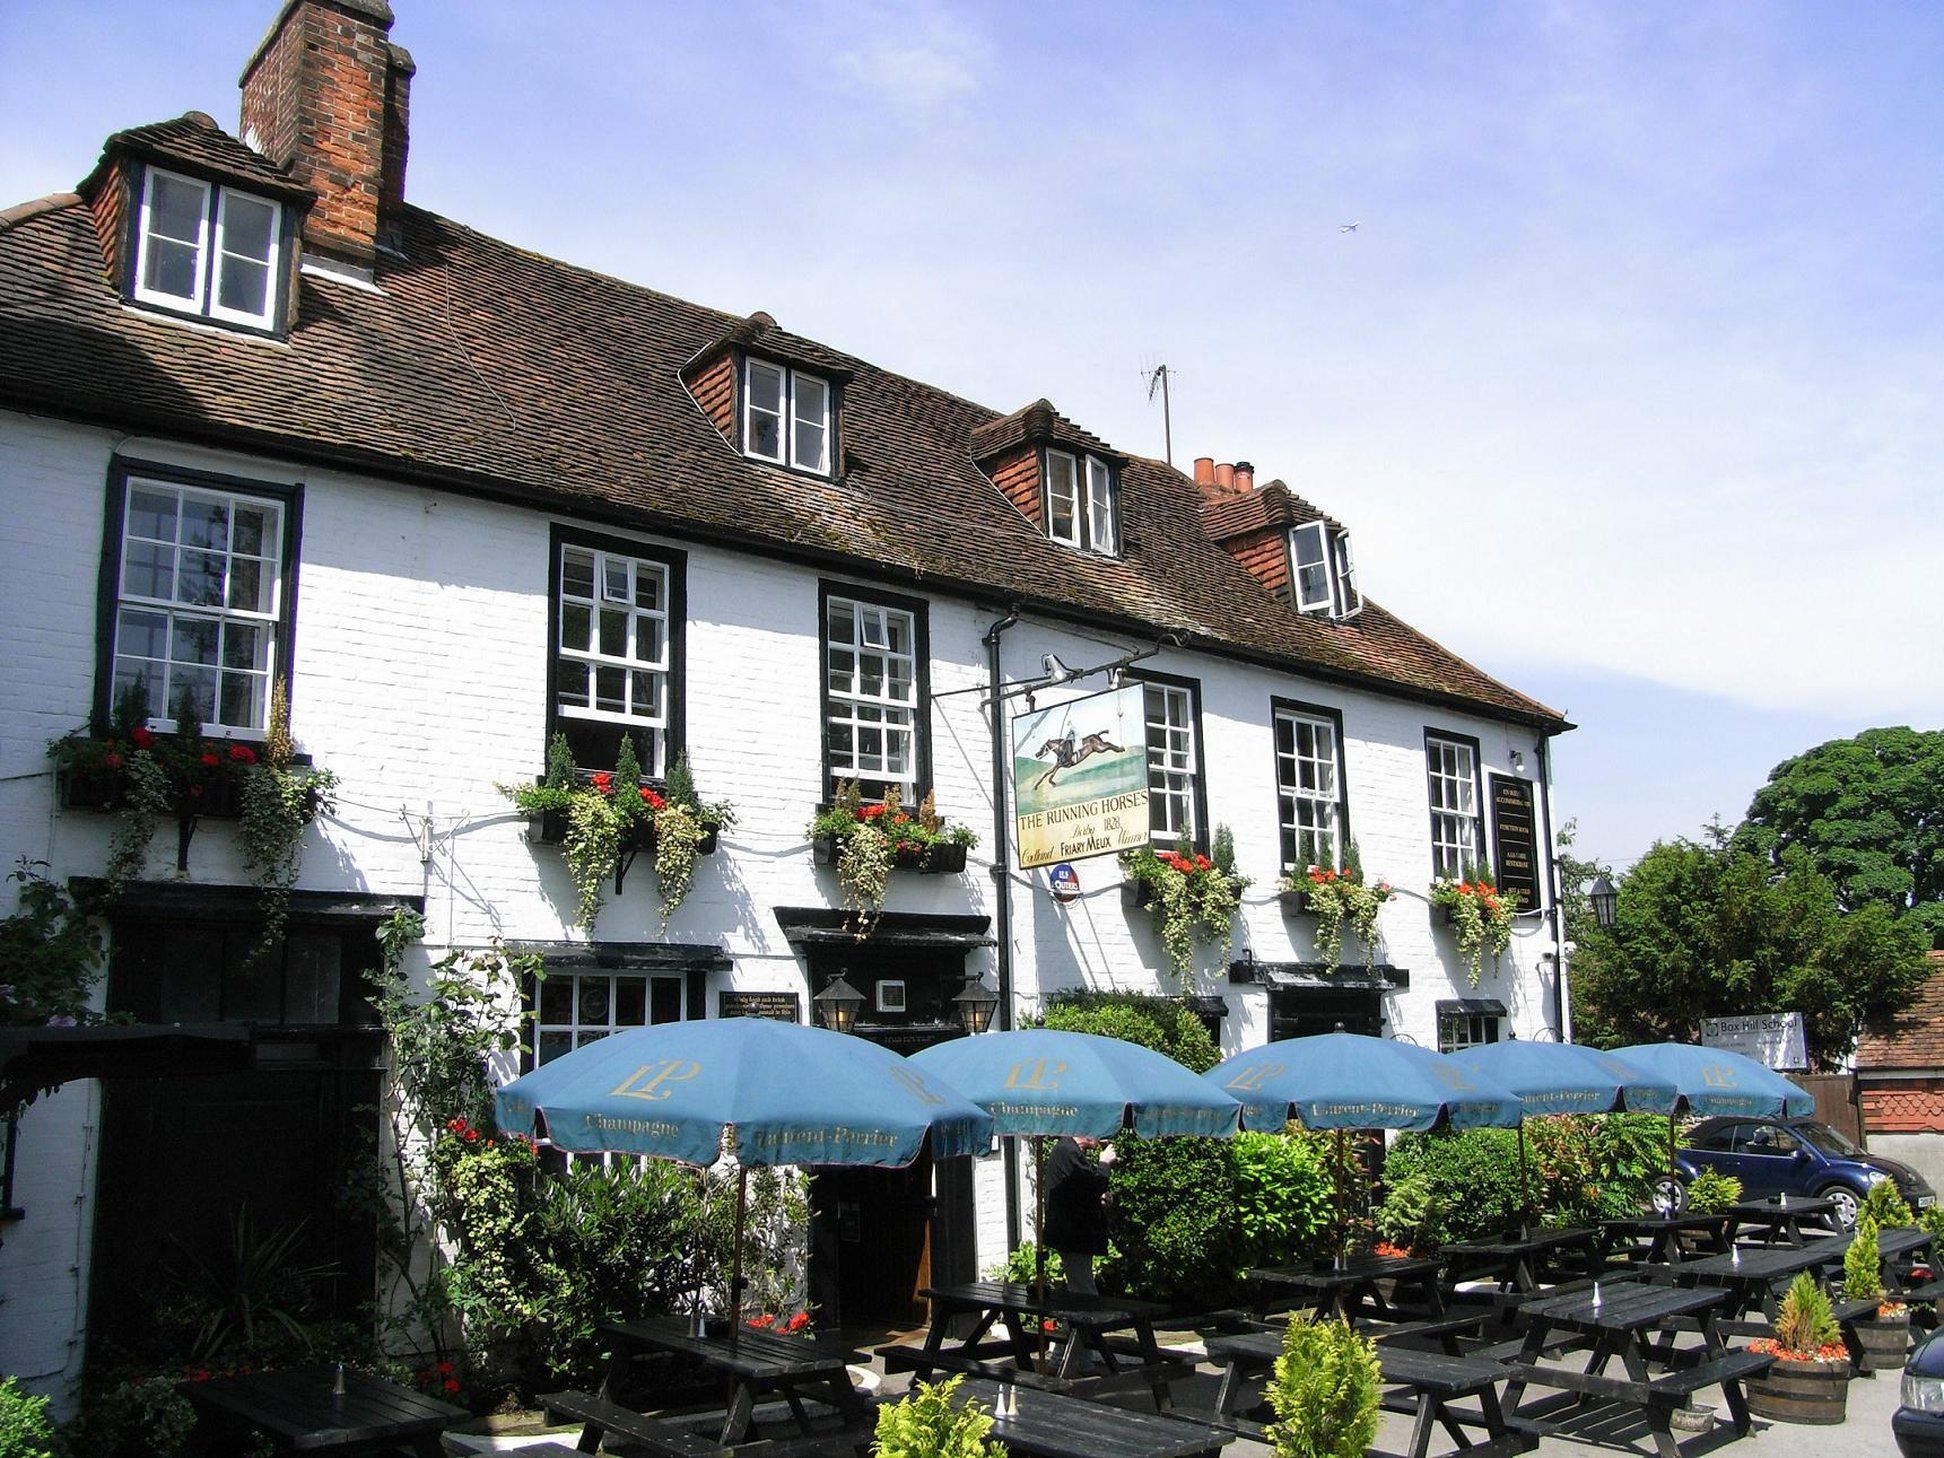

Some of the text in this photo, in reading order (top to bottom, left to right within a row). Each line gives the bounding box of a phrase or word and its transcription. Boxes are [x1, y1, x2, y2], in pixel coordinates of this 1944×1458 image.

[1019, 790, 1148, 830] THE RUNNING HORSES
[1103, 816, 1120, 832] 1828
[1060, 841, 1085, 856] FRIARY
[1086, 835, 1111, 851] MEUX
[1720, 1017, 1797, 1032] Box Hill School
[988, 1101, 1079, 1119] Champagne
[585, 1113, 679, 1138] Champagne
